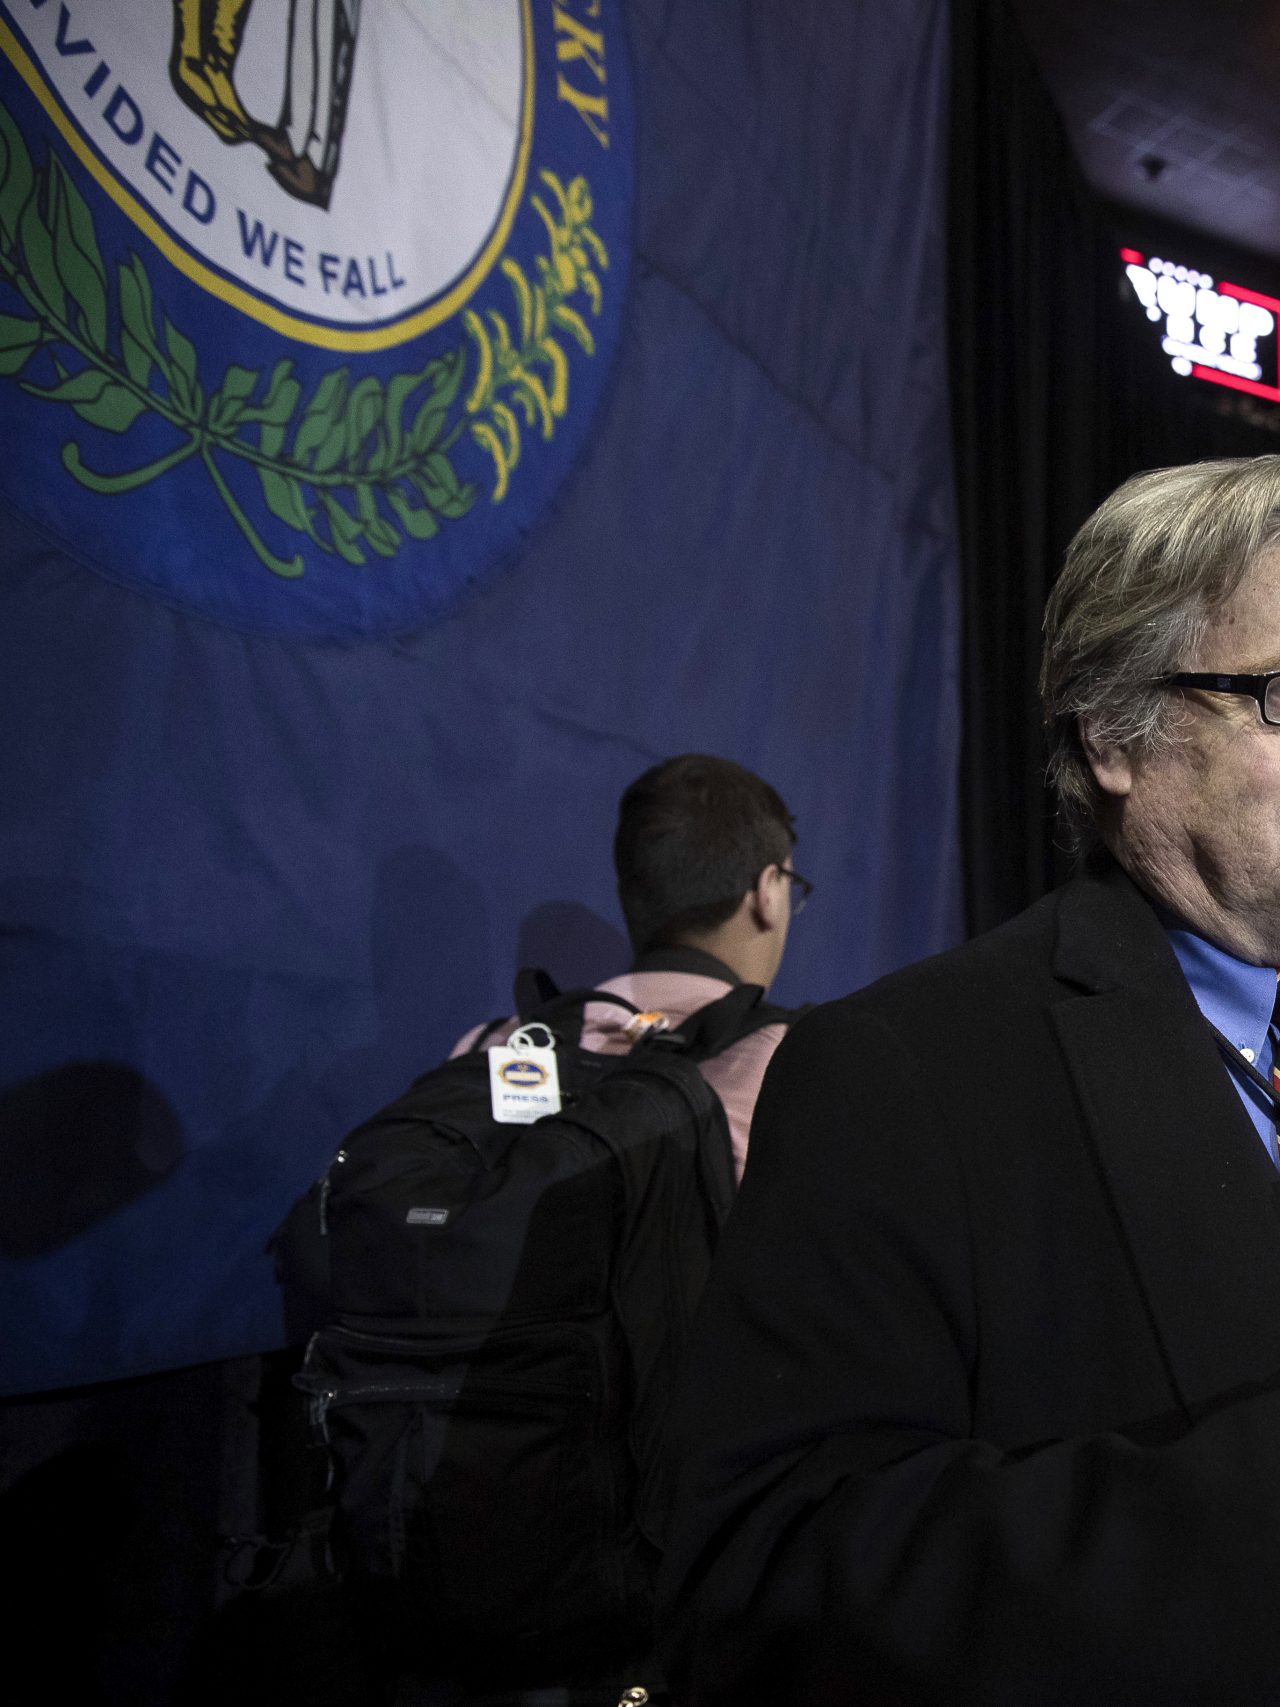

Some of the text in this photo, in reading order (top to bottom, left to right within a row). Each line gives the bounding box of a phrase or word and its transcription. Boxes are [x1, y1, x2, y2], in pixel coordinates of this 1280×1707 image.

[30, 0, 407, 298] VIDED WE FALL
[551, 0, 610, 151] KY
[503, 1093, 549, 1103] PRESS
